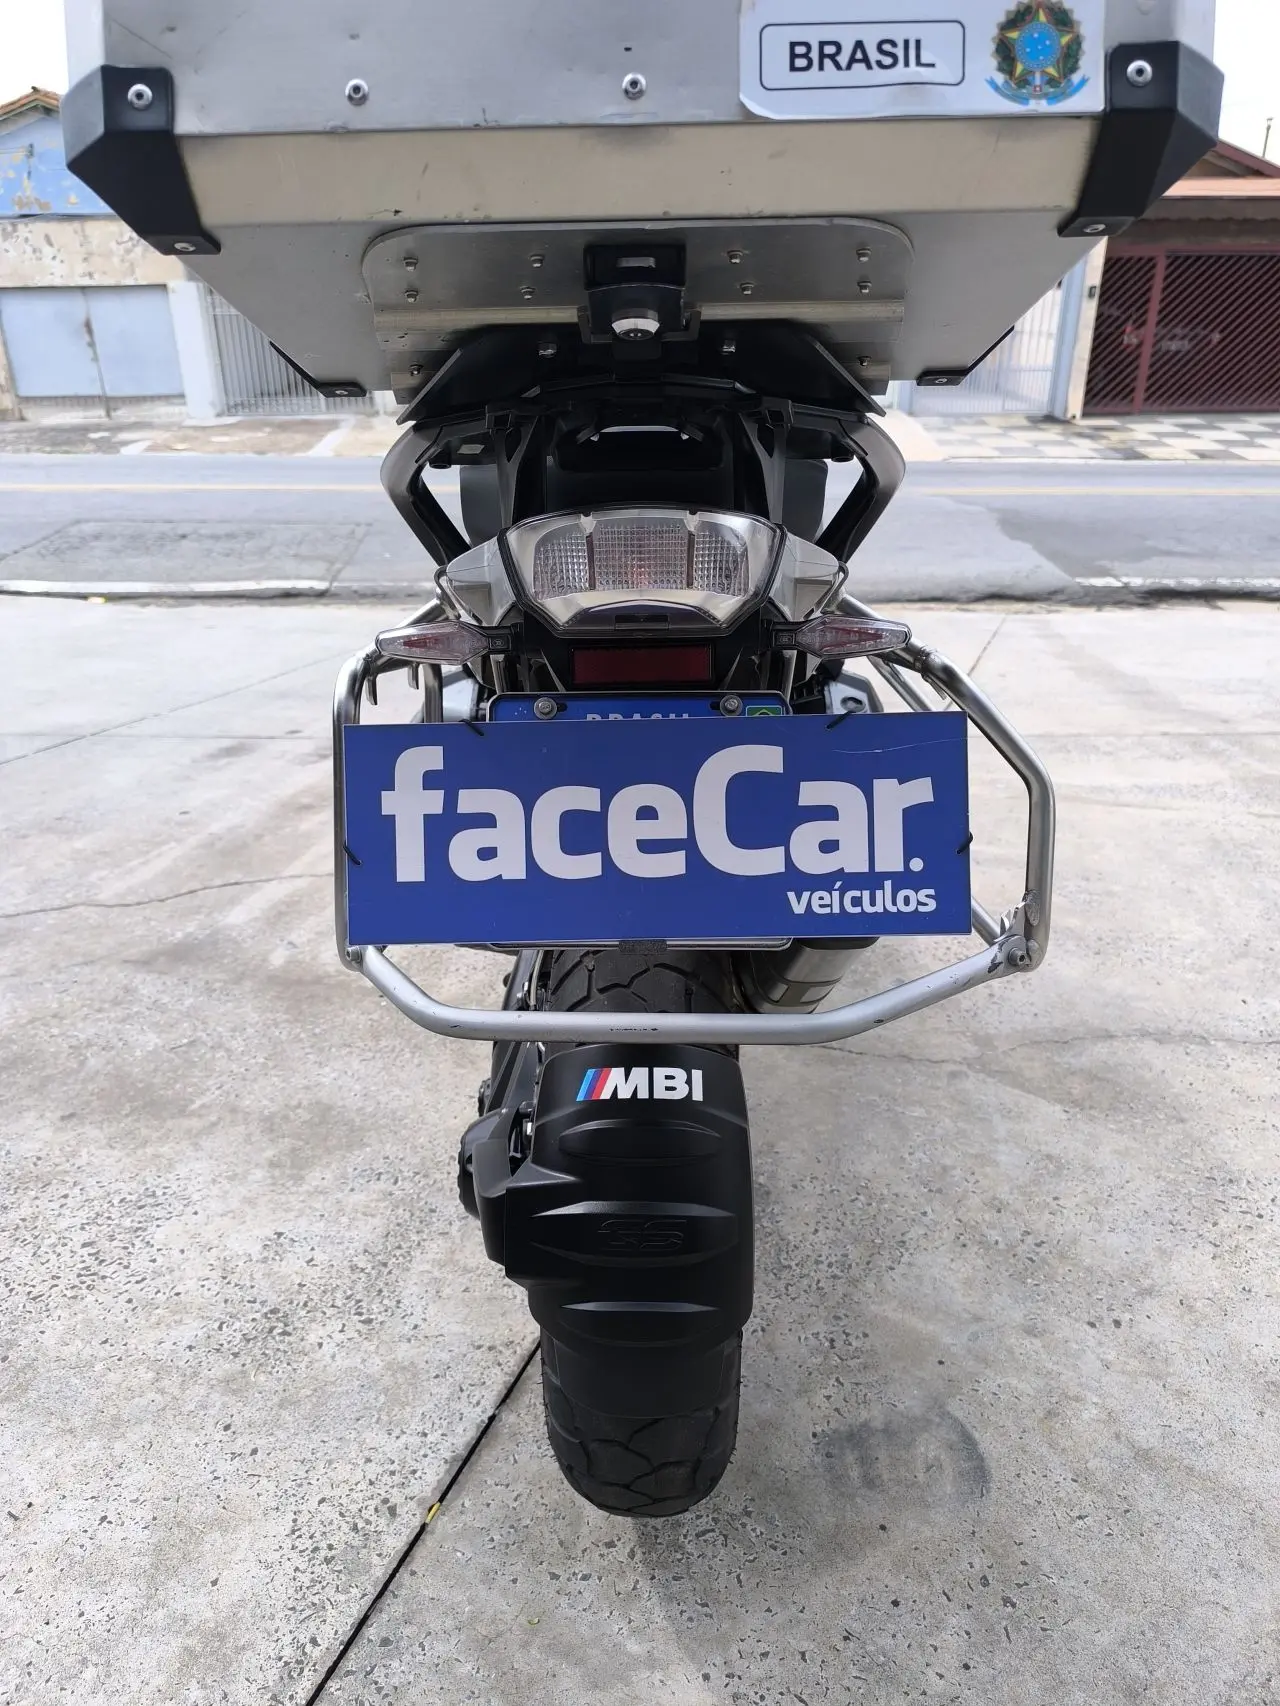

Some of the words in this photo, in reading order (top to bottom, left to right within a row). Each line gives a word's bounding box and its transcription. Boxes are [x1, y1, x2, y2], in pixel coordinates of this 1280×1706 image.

[788, 38, 936, 72] BRASIL
[381, 744, 934, 884] faceCar.
[787, 880, 937, 914] veículos
